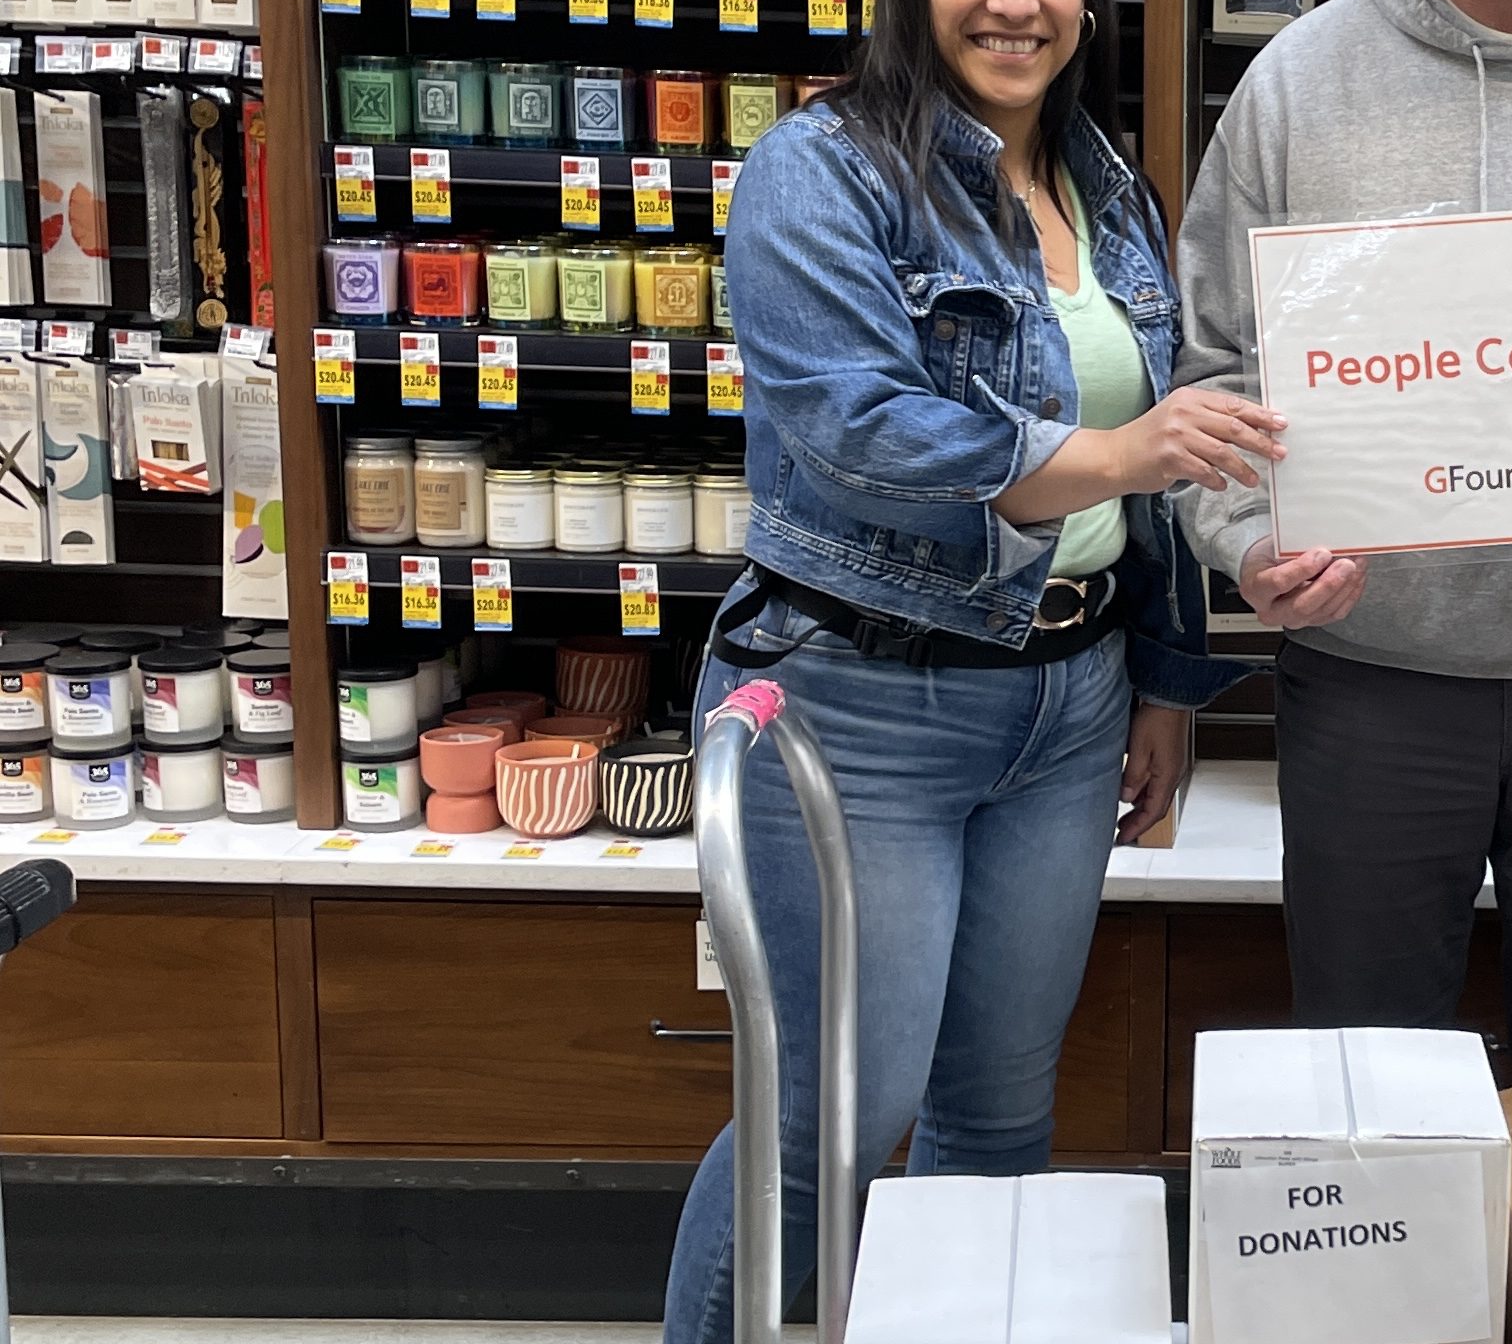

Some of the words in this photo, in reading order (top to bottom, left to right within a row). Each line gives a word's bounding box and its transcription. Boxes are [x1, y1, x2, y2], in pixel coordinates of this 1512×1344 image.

[722, 0, 755, 13] $16.36
[339, 189, 373, 204] $20.45
[414, 189, 448, 204] $20.45
[564, 198, 598, 213] $20.45
[637, 200, 670, 215] $20.45
[1306, 340, 1461, 392] People
[318, 370, 352, 386] $20.45
[403, 374, 437, 388] $20.45
[481, 377, 515, 392] $20.45
[634, 383, 667, 398] $20.45
[710, 384, 743, 399] $20.45
[332, 593, 365, 607] $16.36
[404, 595, 438, 610] $16.36
[476, 598, 509, 613] $20.83
[624, 603, 656, 618] $20.83
[1287, 1184, 1344, 1209] FOR
[1238, 1220, 1408, 1257] DONATIONS
